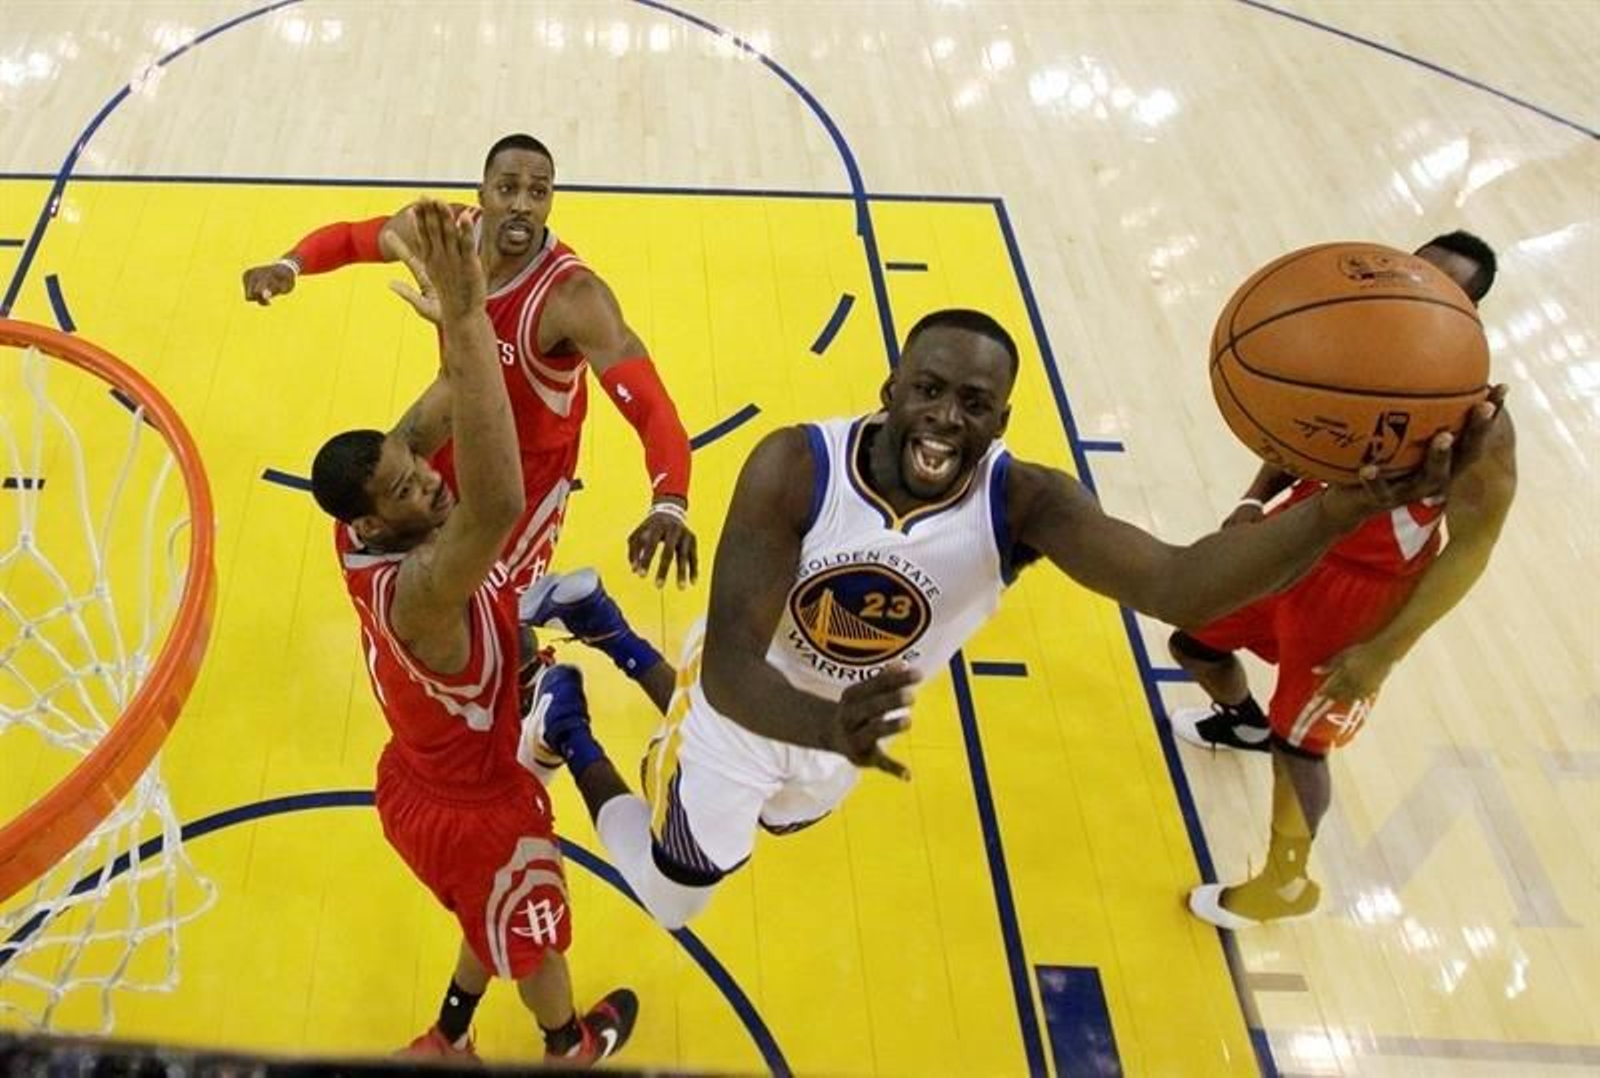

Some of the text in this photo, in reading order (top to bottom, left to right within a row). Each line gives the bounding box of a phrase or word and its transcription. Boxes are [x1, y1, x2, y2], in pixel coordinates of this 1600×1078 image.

[798, 551, 941, 600] GOLDEN STATE
[859, 592, 912, 620] 23
[789, 630, 921, 682] WARRIOS
